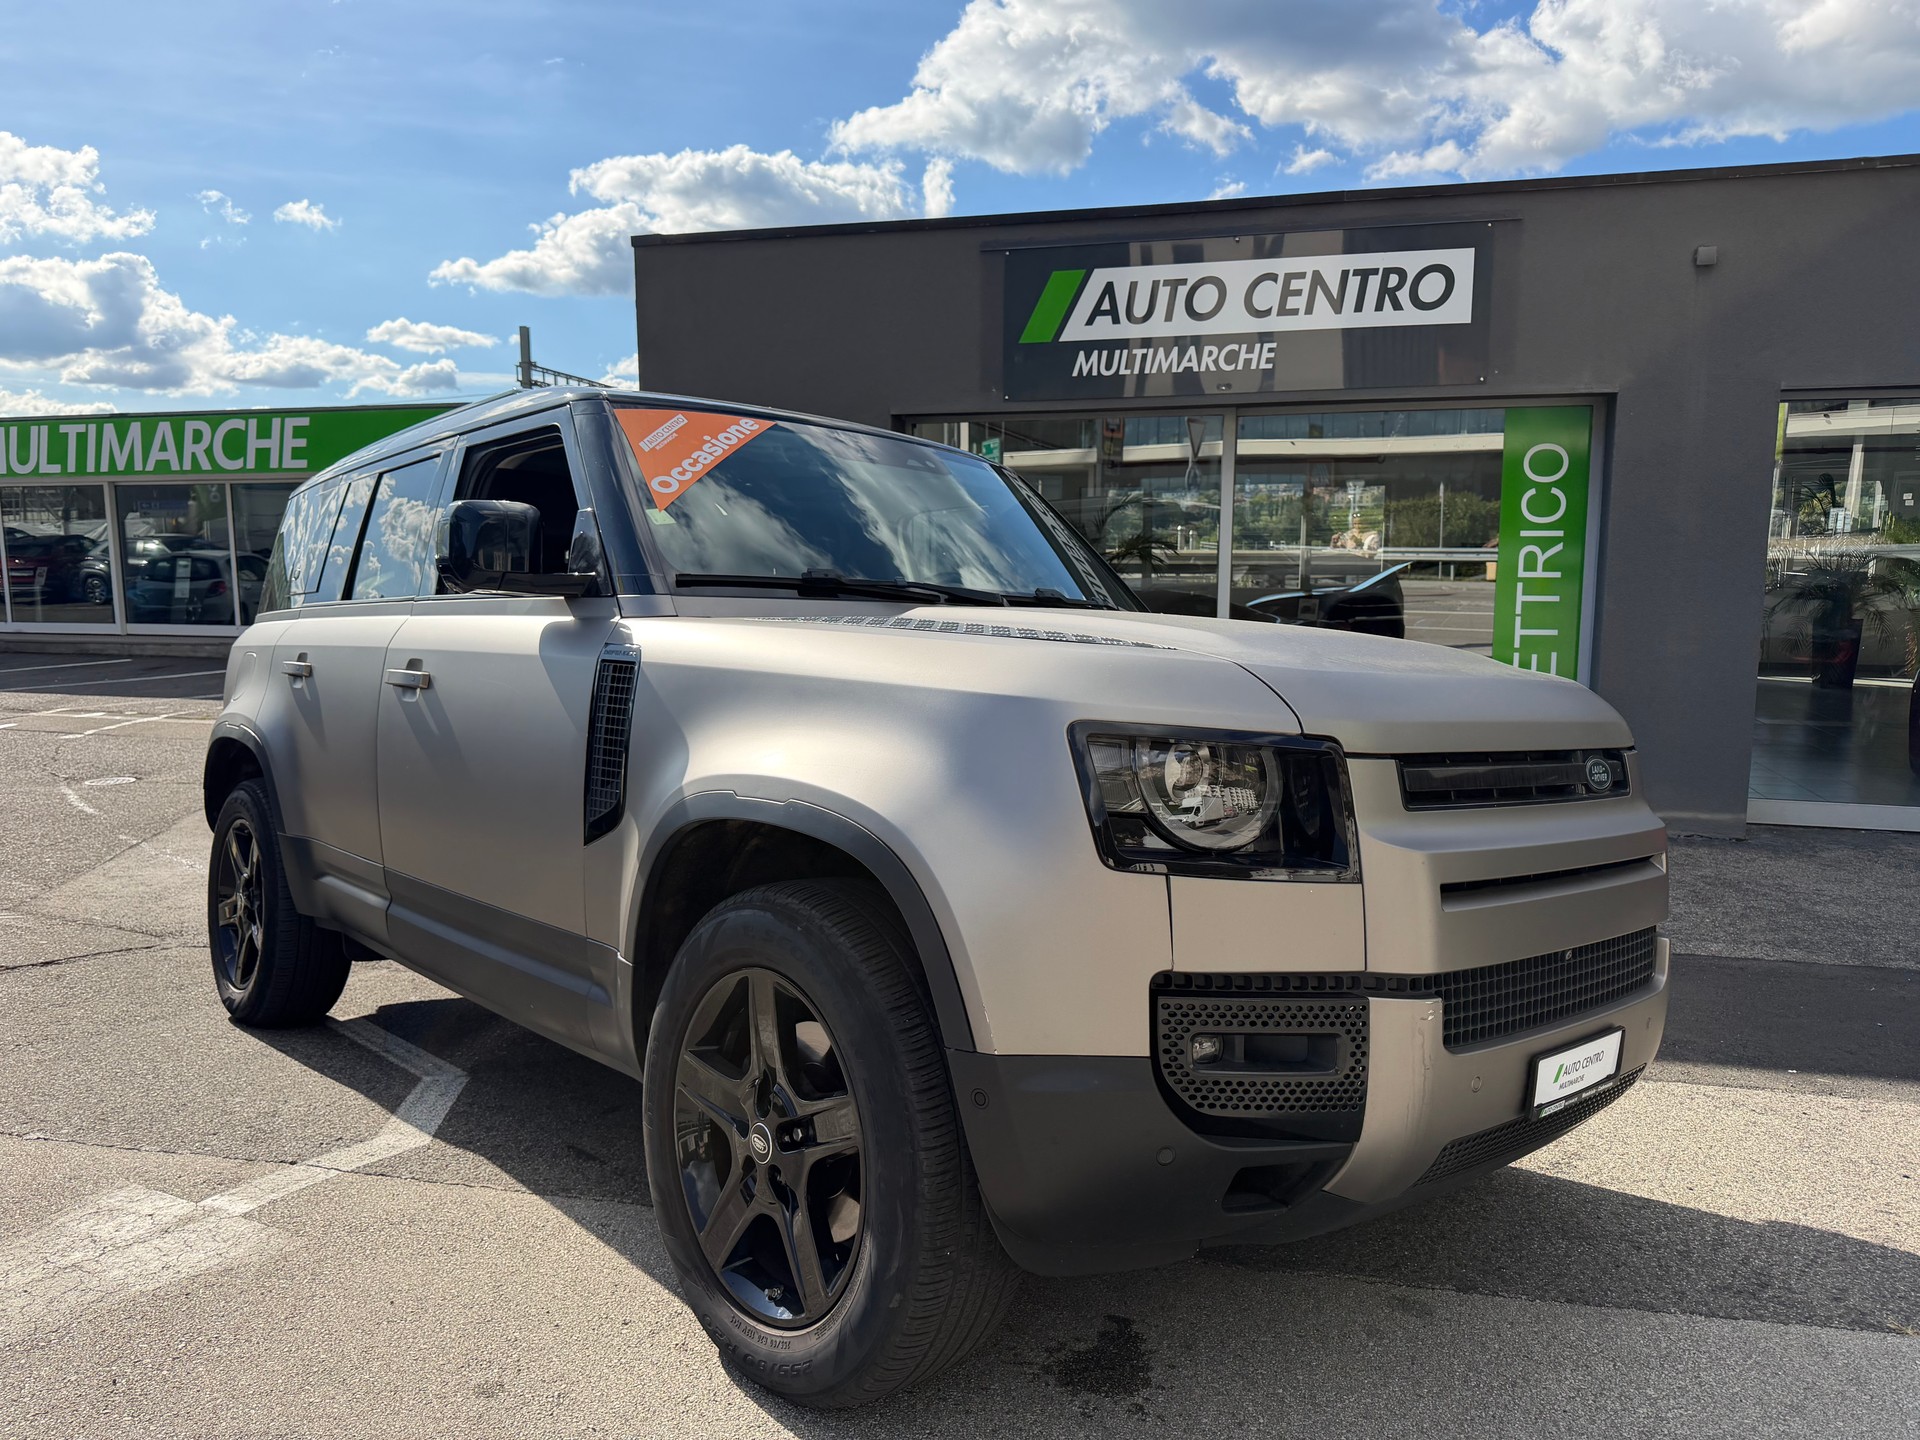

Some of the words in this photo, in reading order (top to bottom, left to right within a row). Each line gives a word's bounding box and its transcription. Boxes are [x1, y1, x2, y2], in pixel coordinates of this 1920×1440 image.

[1084, 275, 1228, 327] AUTO
[1243, 263, 1456, 319] CENTRO
[1071, 342, 1278, 377] MULTIMARCHE
[0, 416, 310, 475] ULTIMARCHE
[646, 431, 664, 446] AUTO
[661, 416, 685, 434] CENTRO
[650, 418, 760, 494] Occasione
[1562, 1060, 1581, 1077] AUTO
[1582, 1050, 1605, 1069] CENTRO
